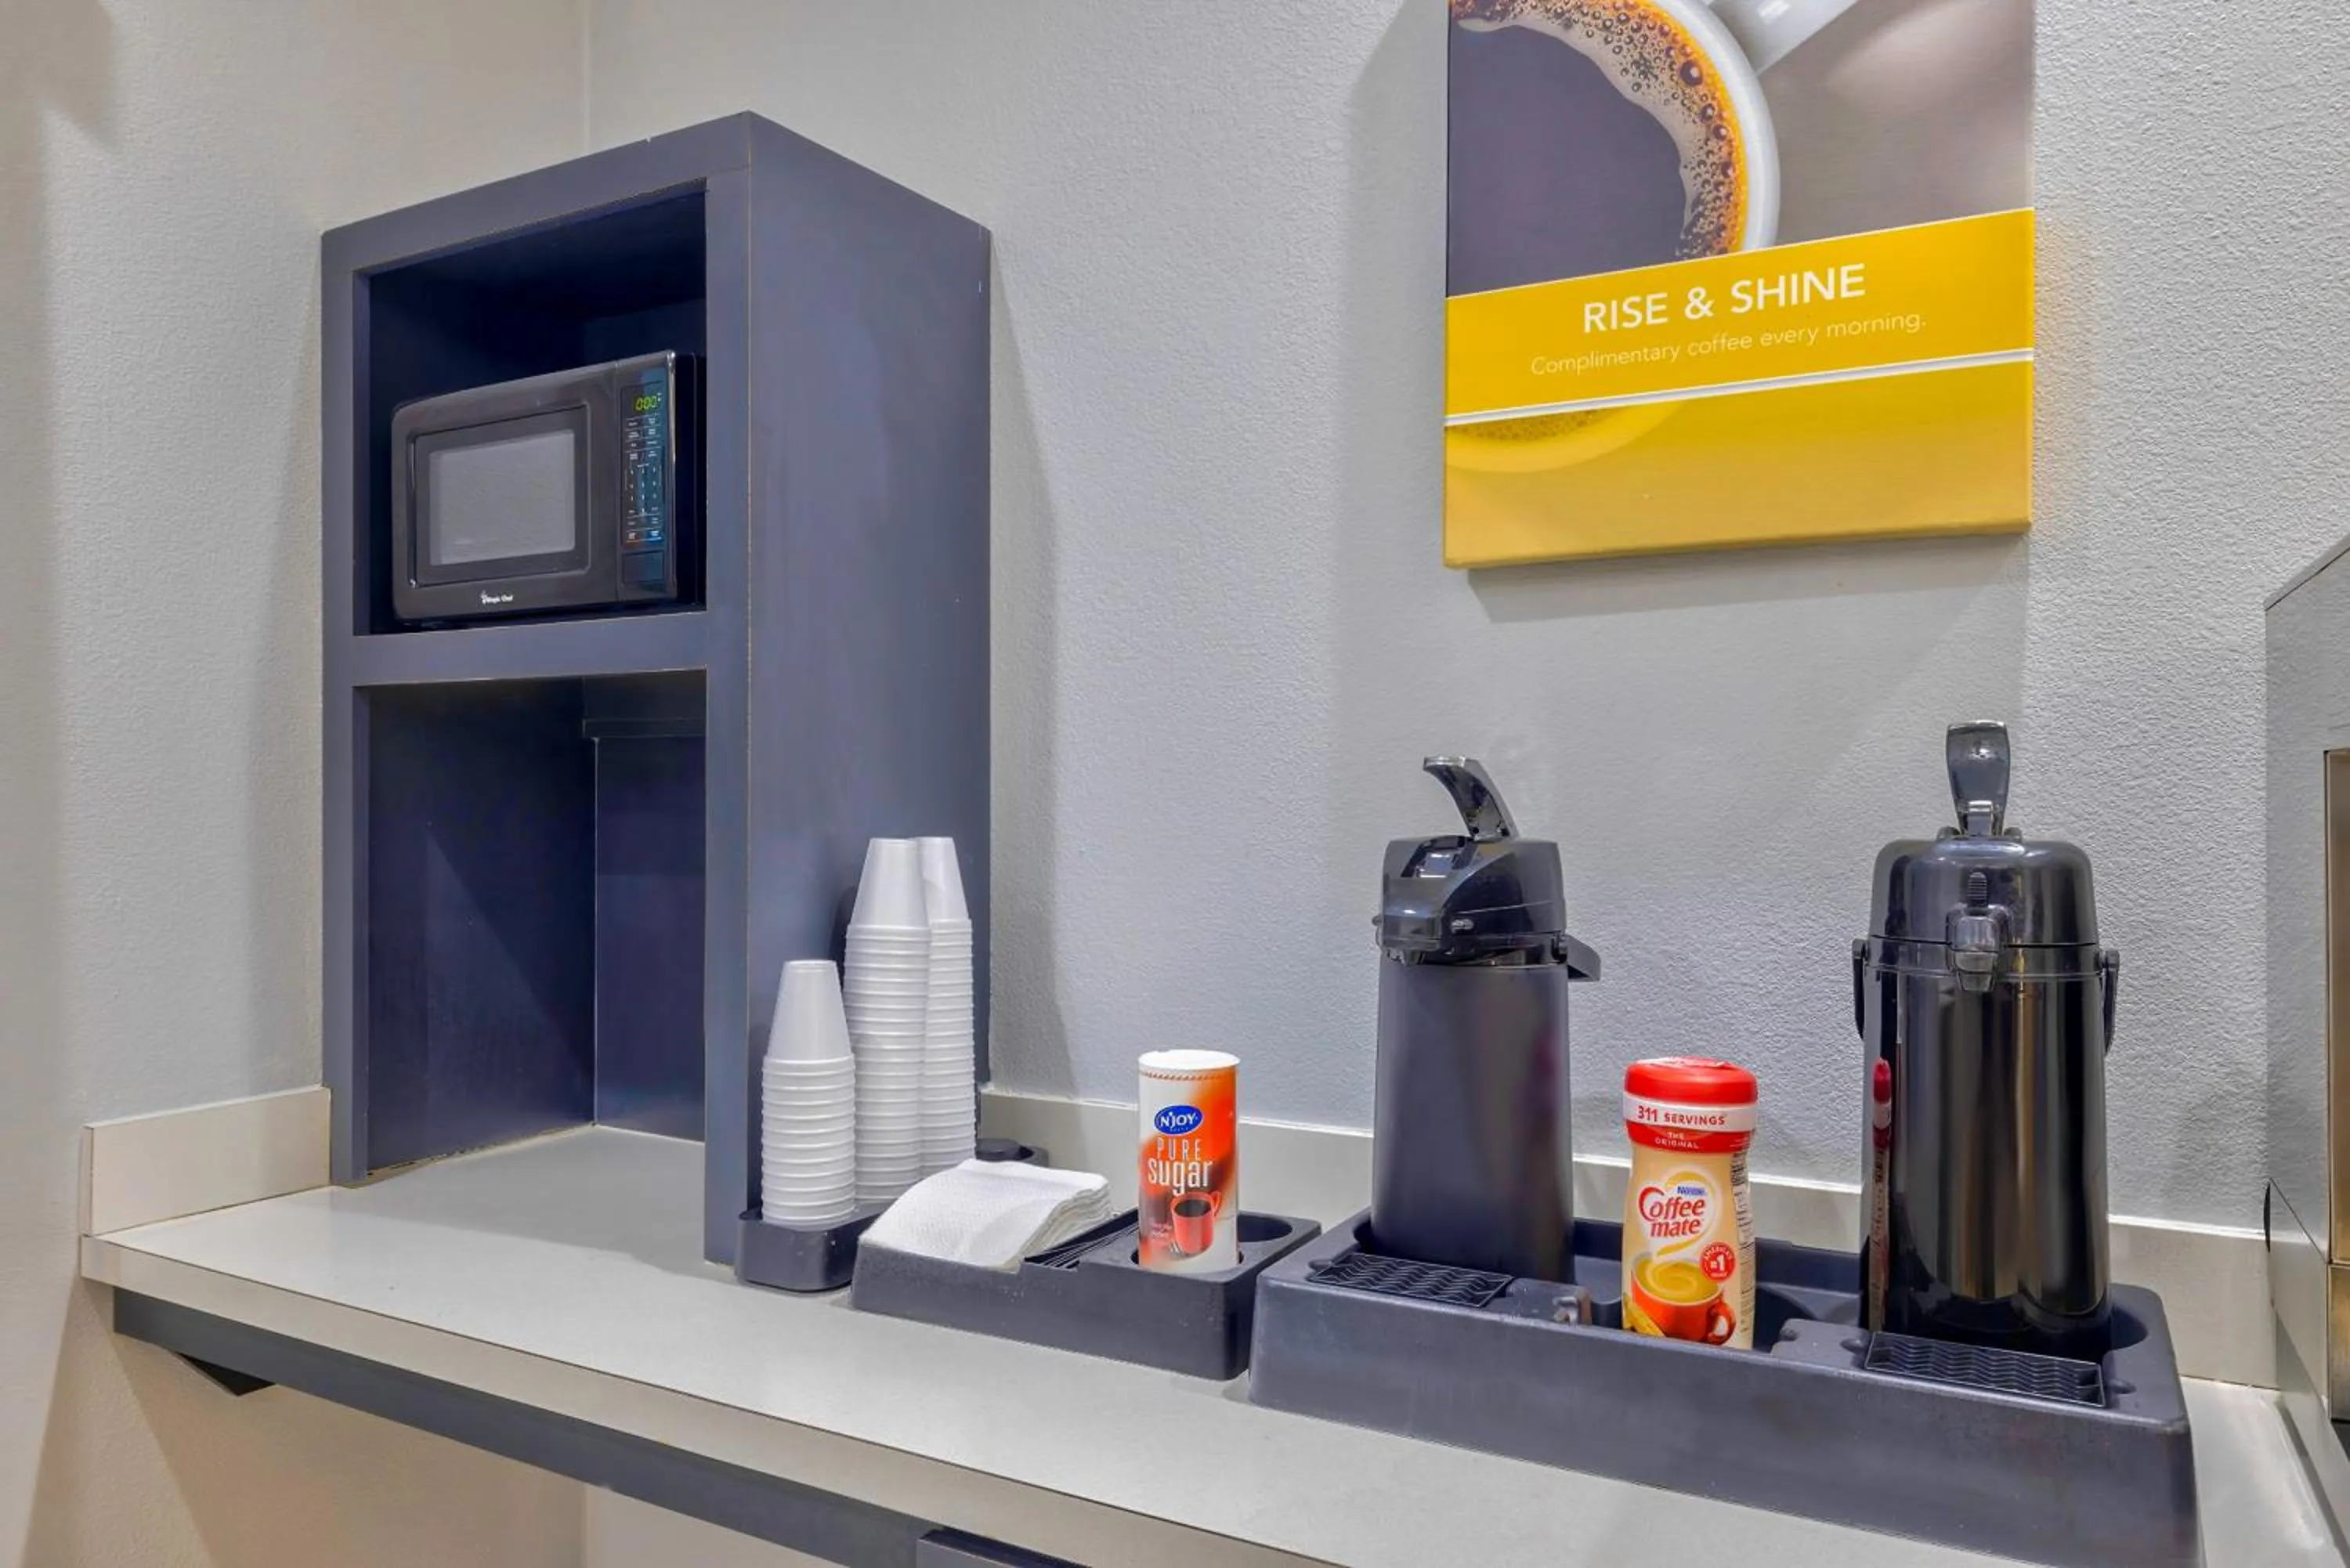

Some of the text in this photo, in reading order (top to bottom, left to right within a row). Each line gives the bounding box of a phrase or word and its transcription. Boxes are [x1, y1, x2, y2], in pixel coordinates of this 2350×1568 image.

[1583, 263, 1866, 334] RISE & SHINE
[1531, 311, 1927, 376] Complimentary coffee every morning.
[1637, 1105, 1726, 1125] 311 SERVINGS
[1157, 1136, 1202, 1160] PURE
[1654, 1137, 1700, 1150] ORIGINAL
[1148, 1157, 1213, 1197] sugar
[1639, 1186, 1705, 1222] Coffee
[1650, 1219, 1701, 1237] mate
